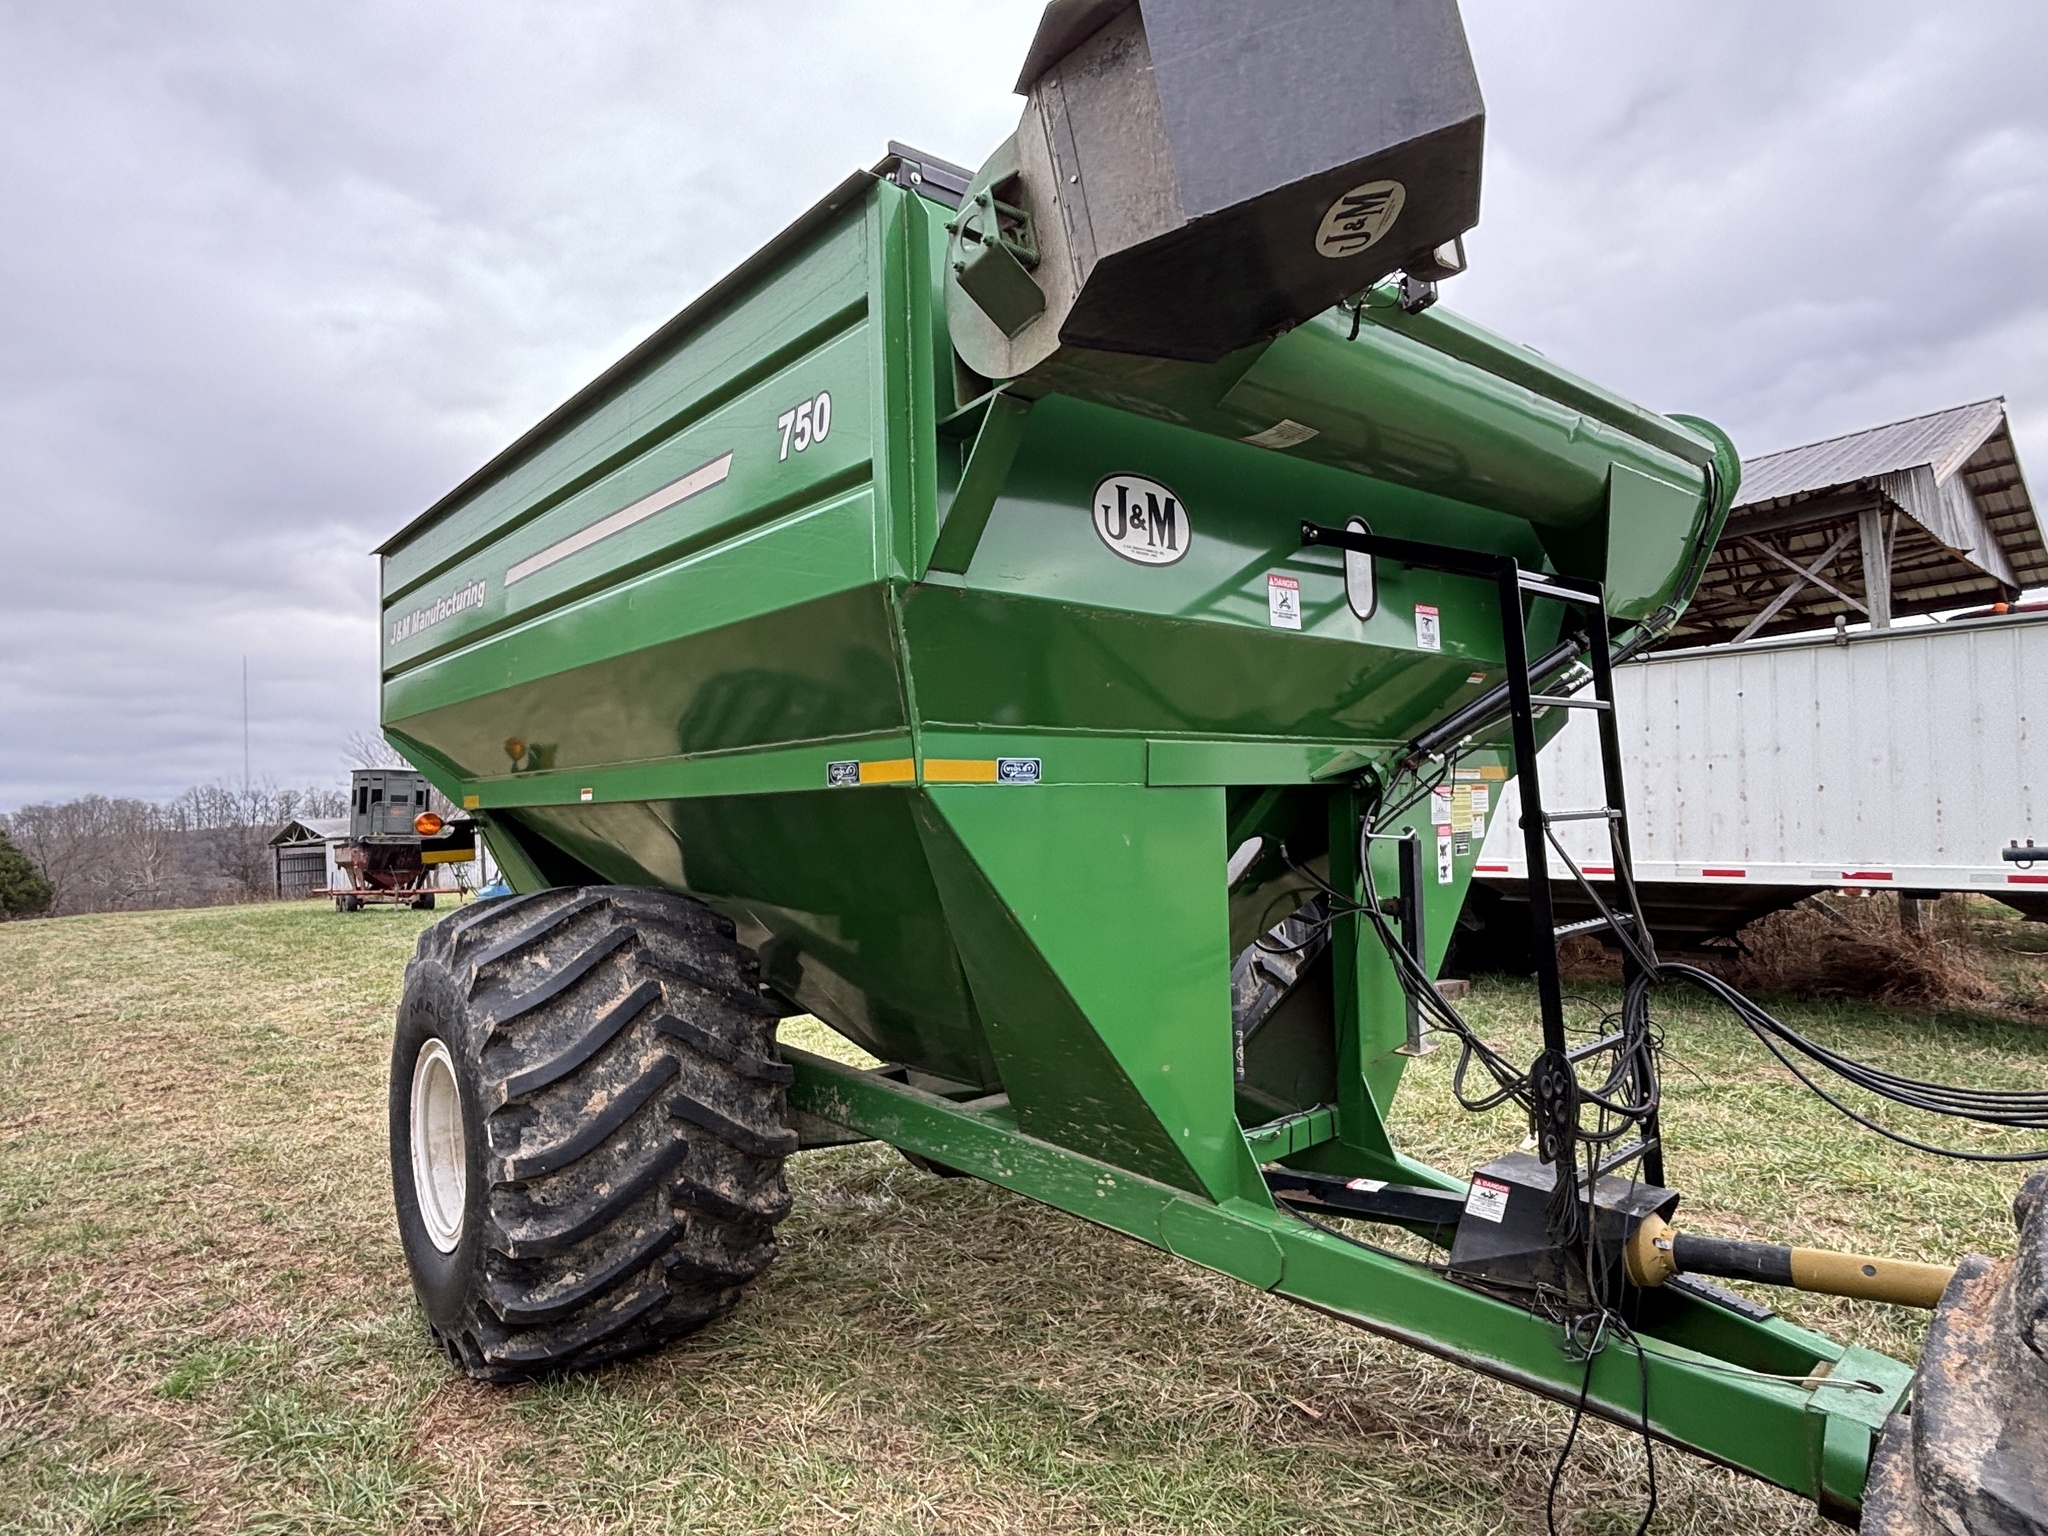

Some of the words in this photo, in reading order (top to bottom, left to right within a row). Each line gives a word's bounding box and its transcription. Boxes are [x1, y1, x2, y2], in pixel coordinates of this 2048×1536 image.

[1324, 188, 1394, 253] J&M
[778, 390, 832, 463] 750
[1101, 485, 1178, 551] J&M
[390, 615, 410, 646] J&M
[411, 579, 486, 635] Manufacturing
[1482, 1180, 1509, 1192] DANGER
